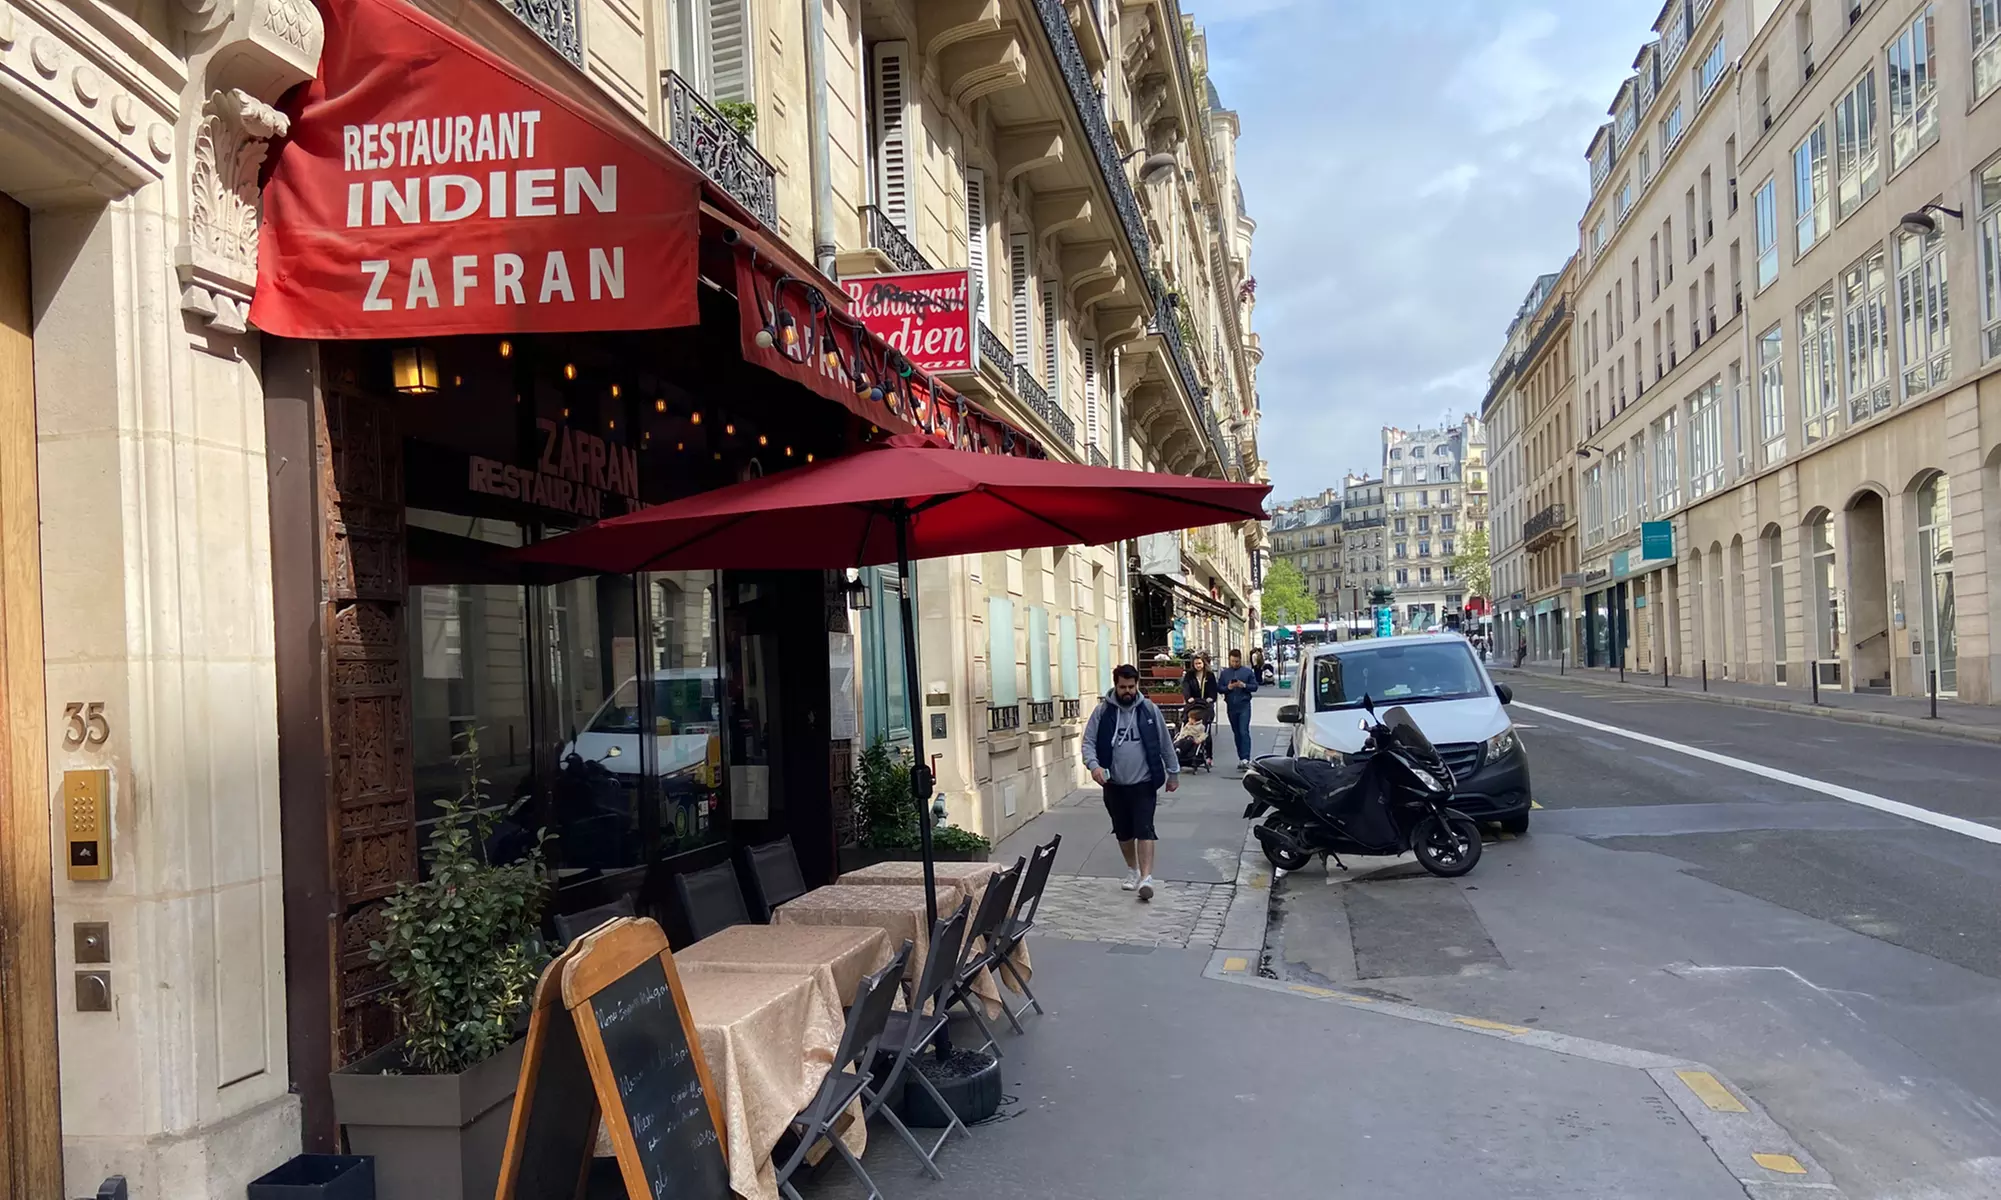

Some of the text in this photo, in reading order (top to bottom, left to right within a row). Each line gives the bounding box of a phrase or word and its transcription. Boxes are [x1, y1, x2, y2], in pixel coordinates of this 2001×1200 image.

[343, 110, 541, 172] RESTAURANT
[346, 165, 617, 228] INDIEN
[361, 246, 625, 312] ZAFRAN
[468, 454, 605, 519] RESTAURAN
[535, 417, 639, 497] ZAFRAN
[62, 702, 110, 745] 35
